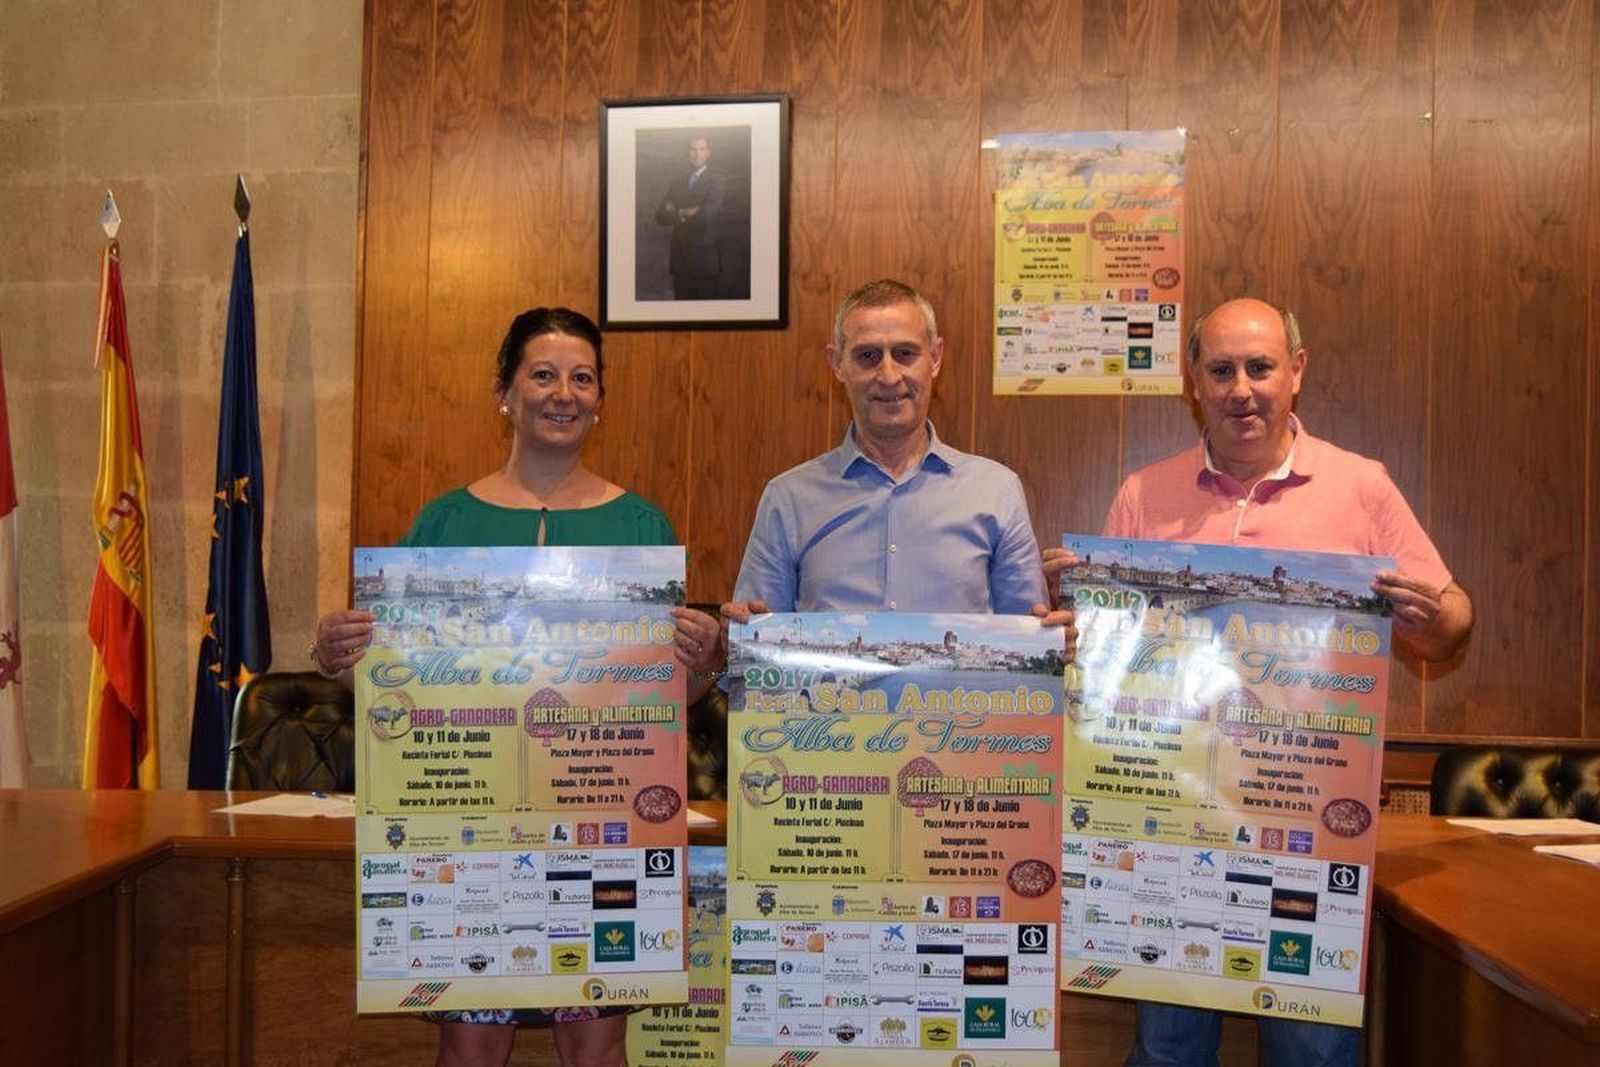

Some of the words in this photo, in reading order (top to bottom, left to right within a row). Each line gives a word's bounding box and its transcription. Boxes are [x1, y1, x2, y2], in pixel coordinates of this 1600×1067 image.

[1074, 587, 1144, 611] 2017
[525, 616, 675, 644] Antonio
[1144, 608, 1213, 639] San
[1222, 613, 1380, 655] Antonio
[369, 650, 480, 687] Alba
[542, 649, 673, 684] Tormes
[1240, 651, 1375, 693] Tormes
[745, 665, 815, 689] 2017
[745, 690, 810, 712] Feria
[814, 682, 888, 713] San
[896, 682, 1054, 715] Antonio
[533, 706, 590, 724] ARTESANA
[601, 705, 675, 723] ALIMENTARIA
[1226, 706, 1283, 727] ARTESANA
[1285, 713, 1294, 730] y
[1296, 712, 1373, 735] ALIMENTARIA
[1119, 720, 1125, 731] y
[1129, 718, 1137, 730] 11
[1140, 720, 1152, 731] de
[427, 733, 433, 744] y
[437, 731, 445, 743] 11
[448, 731, 460, 743] de
[463, 730, 490, 742] Junio
[567, 728, 576, 741] 17
[580, 731, 587, 742] y
[590, 728, 600, 741] 18
[603, 728, 615, 740] de
[617, 727, 645, 740] Junio
[743, 714, 855, 752] Alba
[864, 717, 910, 752] de
[917, 717, 1052, 753] Tormes
[1259, 730, 1269, 743] 17
[1272, 735, 1279, 745] y
[1283, 732, 1293, 745] 18
[1296, 734, 1308, 746] de
[1311, 736, 1339, 749] Junio
[551, 748, 570, 757] Plaza
[571, 748, 593, 757] Mayor
[602, 748, 621, 756] Plaza
[1241, 749, 1260, 759] Plaza
[1262, 751, 1285, 761] Mayor
[1293, 754, 1312, 764] Plaza
[445, 781, 453, 789] de
[588, 779, 597, 787] de
[907, 776, 964, 794] ARTESANA
[966, 780, 975, 797] y
[976, 777, 1052, 795] ALIMENTARIA
[1277, 782, 1285, 792] de
[1146, 787, 1154, 795] de
[429, 797, 435, 805] A
[460, 797, 468, 805] de
[786, 797, 796, 811] 10
[800, 800, 806, 811] y
[809, 797, 817, 811] 11
[820, 798, 832, 811] de
[835, 798, 863, 811] Junio
[941, 800, 950, 812] 17
[954, 803, 961, 813] y
[964, 800, 974, 812] 18
[977, 800, 989, 812] de
[992, 800, 1020, 812] Junio
[924, 819, 943, 828] Plaza
[944, 820, 967, 829] Mayor
[975, 820, 995, 828] Plaza
[997, 820, 1007, 828] del
[816, 848, 824, 857] de
[961, 851, 970, 859] de
[800, 865, 806, 873] A
[831, 866, 839, 874] de
[1259, 989, 1321, 1016] DURÁN
[673, 1007, 679, 1018] 11
[682, 1007, 692, 1018] de
[695, 1007, 719, 1018] Junio
